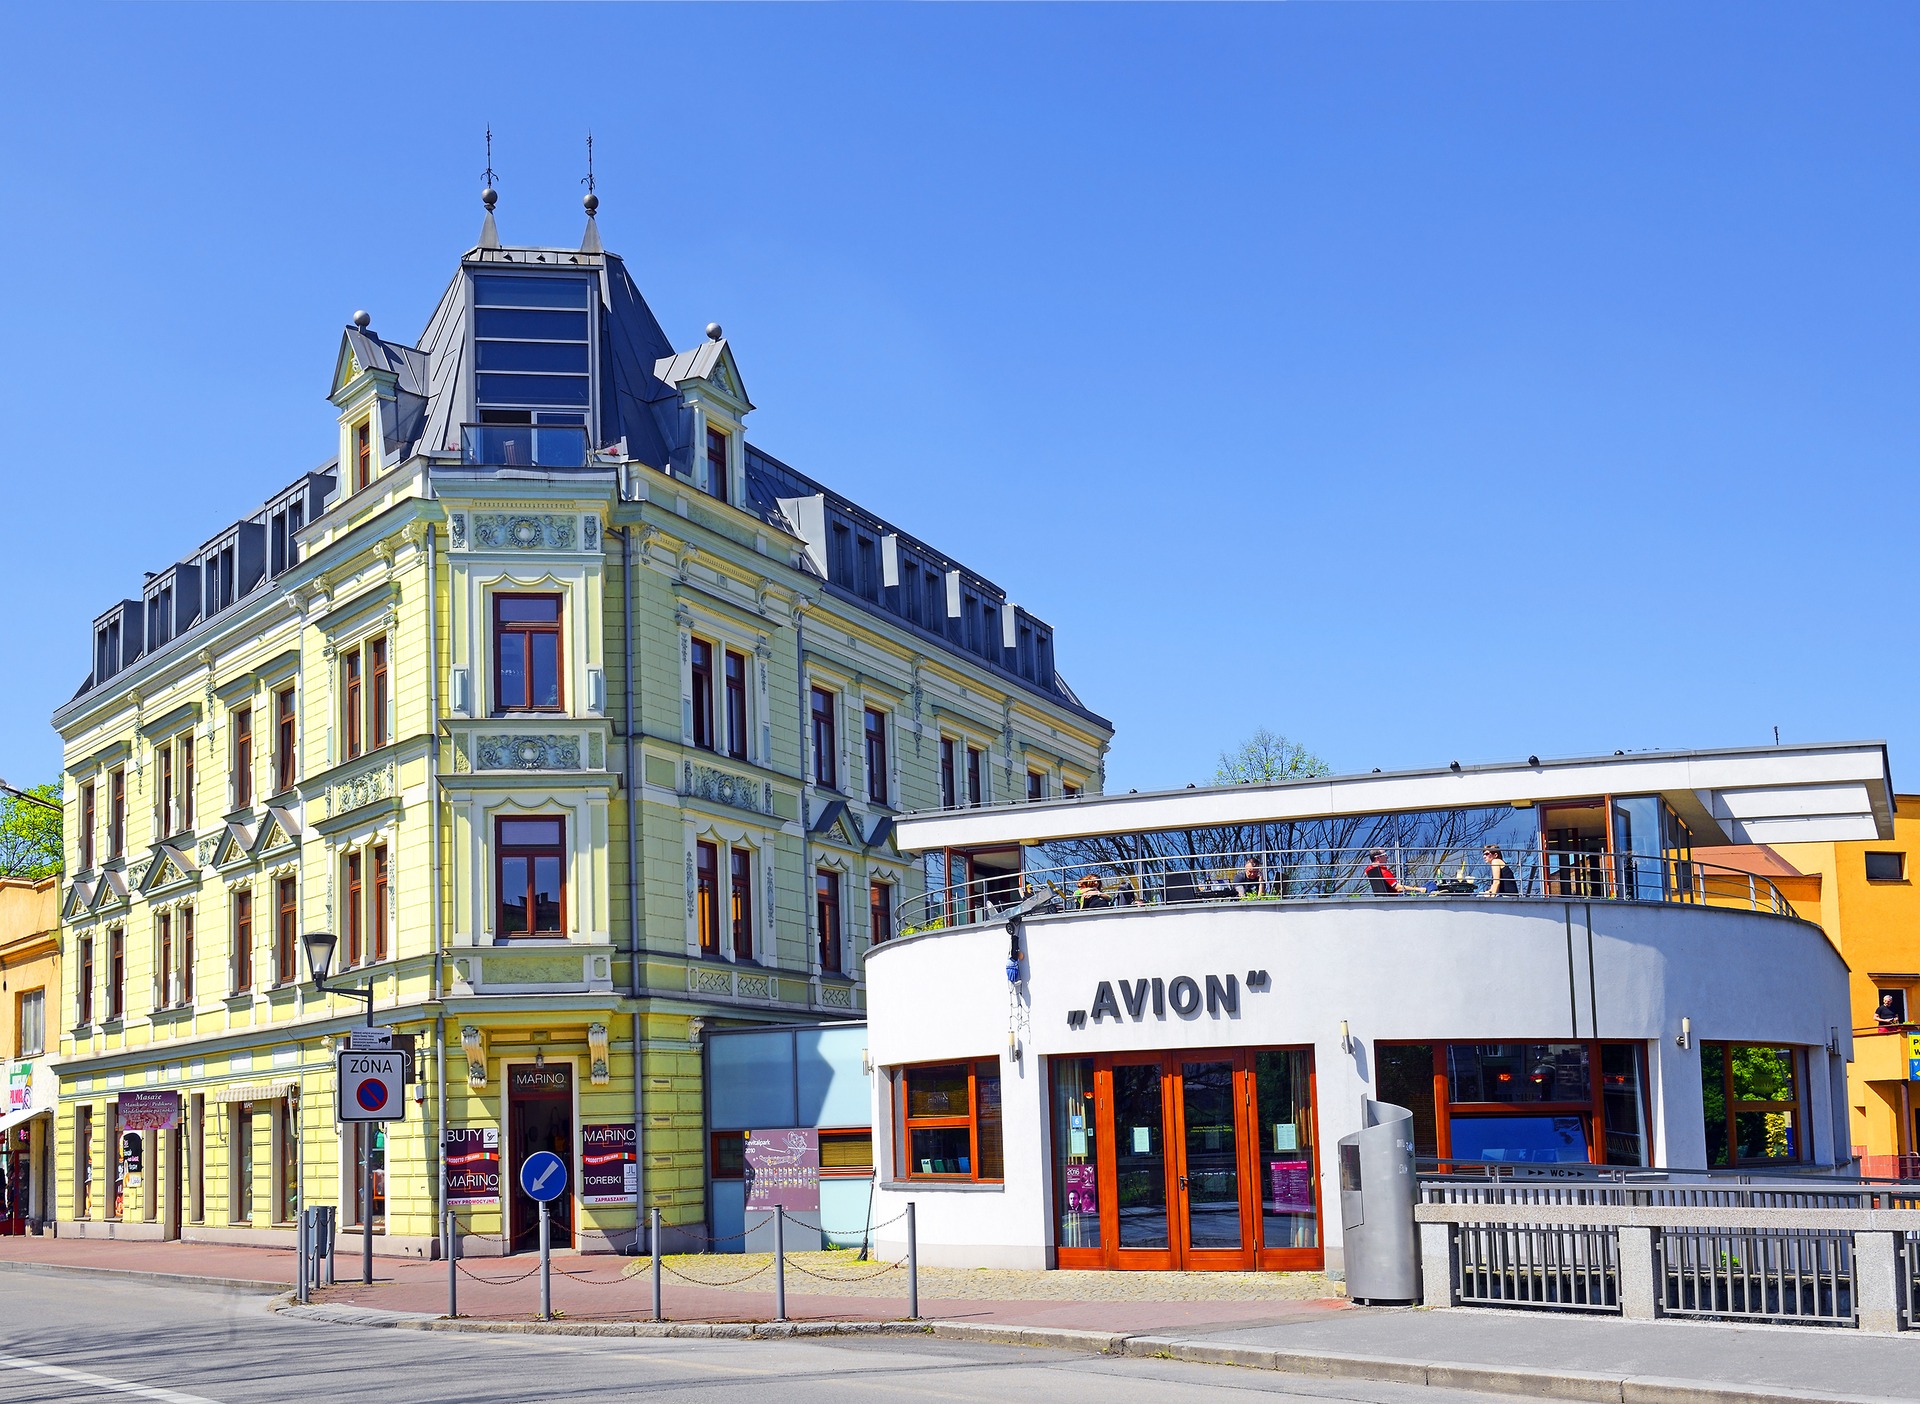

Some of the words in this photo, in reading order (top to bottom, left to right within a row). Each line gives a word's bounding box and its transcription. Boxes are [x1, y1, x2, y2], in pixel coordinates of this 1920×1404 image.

[350, 1056, 393, 1073] ZÓNA
[516, 1073, 565, 1084] MARINO
[135, 1093, 162, 1101] Masaże
[446, 1129, 482, 1142] BUTY
[584, 1129, 636, 1142] MARINO
[745, 1139, 771, 1147] Revitalpark
[1067, 1168, 1080, 1176] 2016
[1550, 1169, 1565, 1177] WC
[446, 1173, 499, 1187] MARINO
[584, 1176, 622, 1185] TOREBKI
